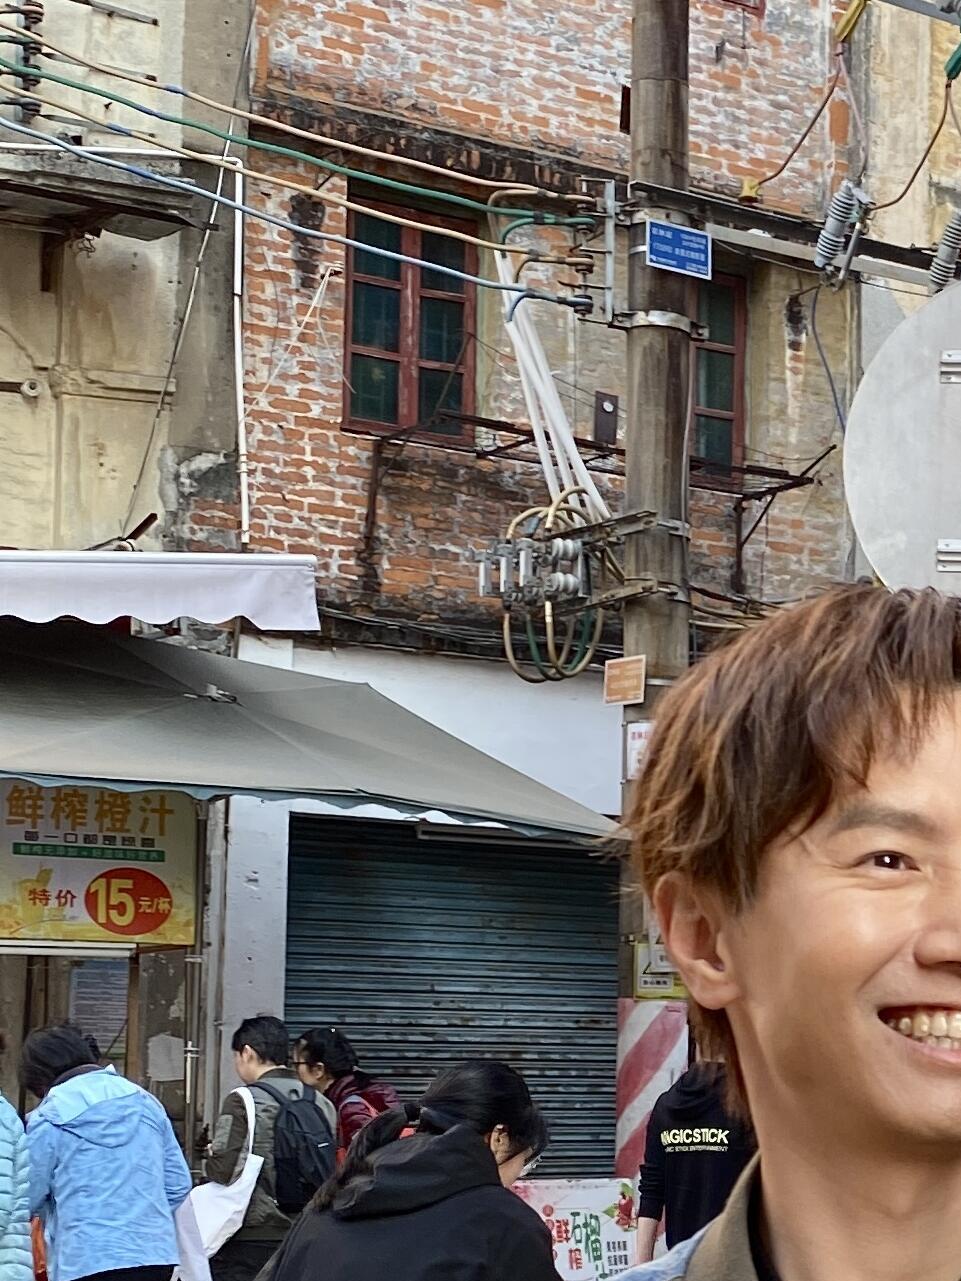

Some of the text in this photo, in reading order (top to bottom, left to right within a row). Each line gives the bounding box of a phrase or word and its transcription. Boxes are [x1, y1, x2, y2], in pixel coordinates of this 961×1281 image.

[6, 784, 175, 837] 鲜榨橙汁
[28, 889, 77, 908] 特价
[89, 878, 136, 927] 15
